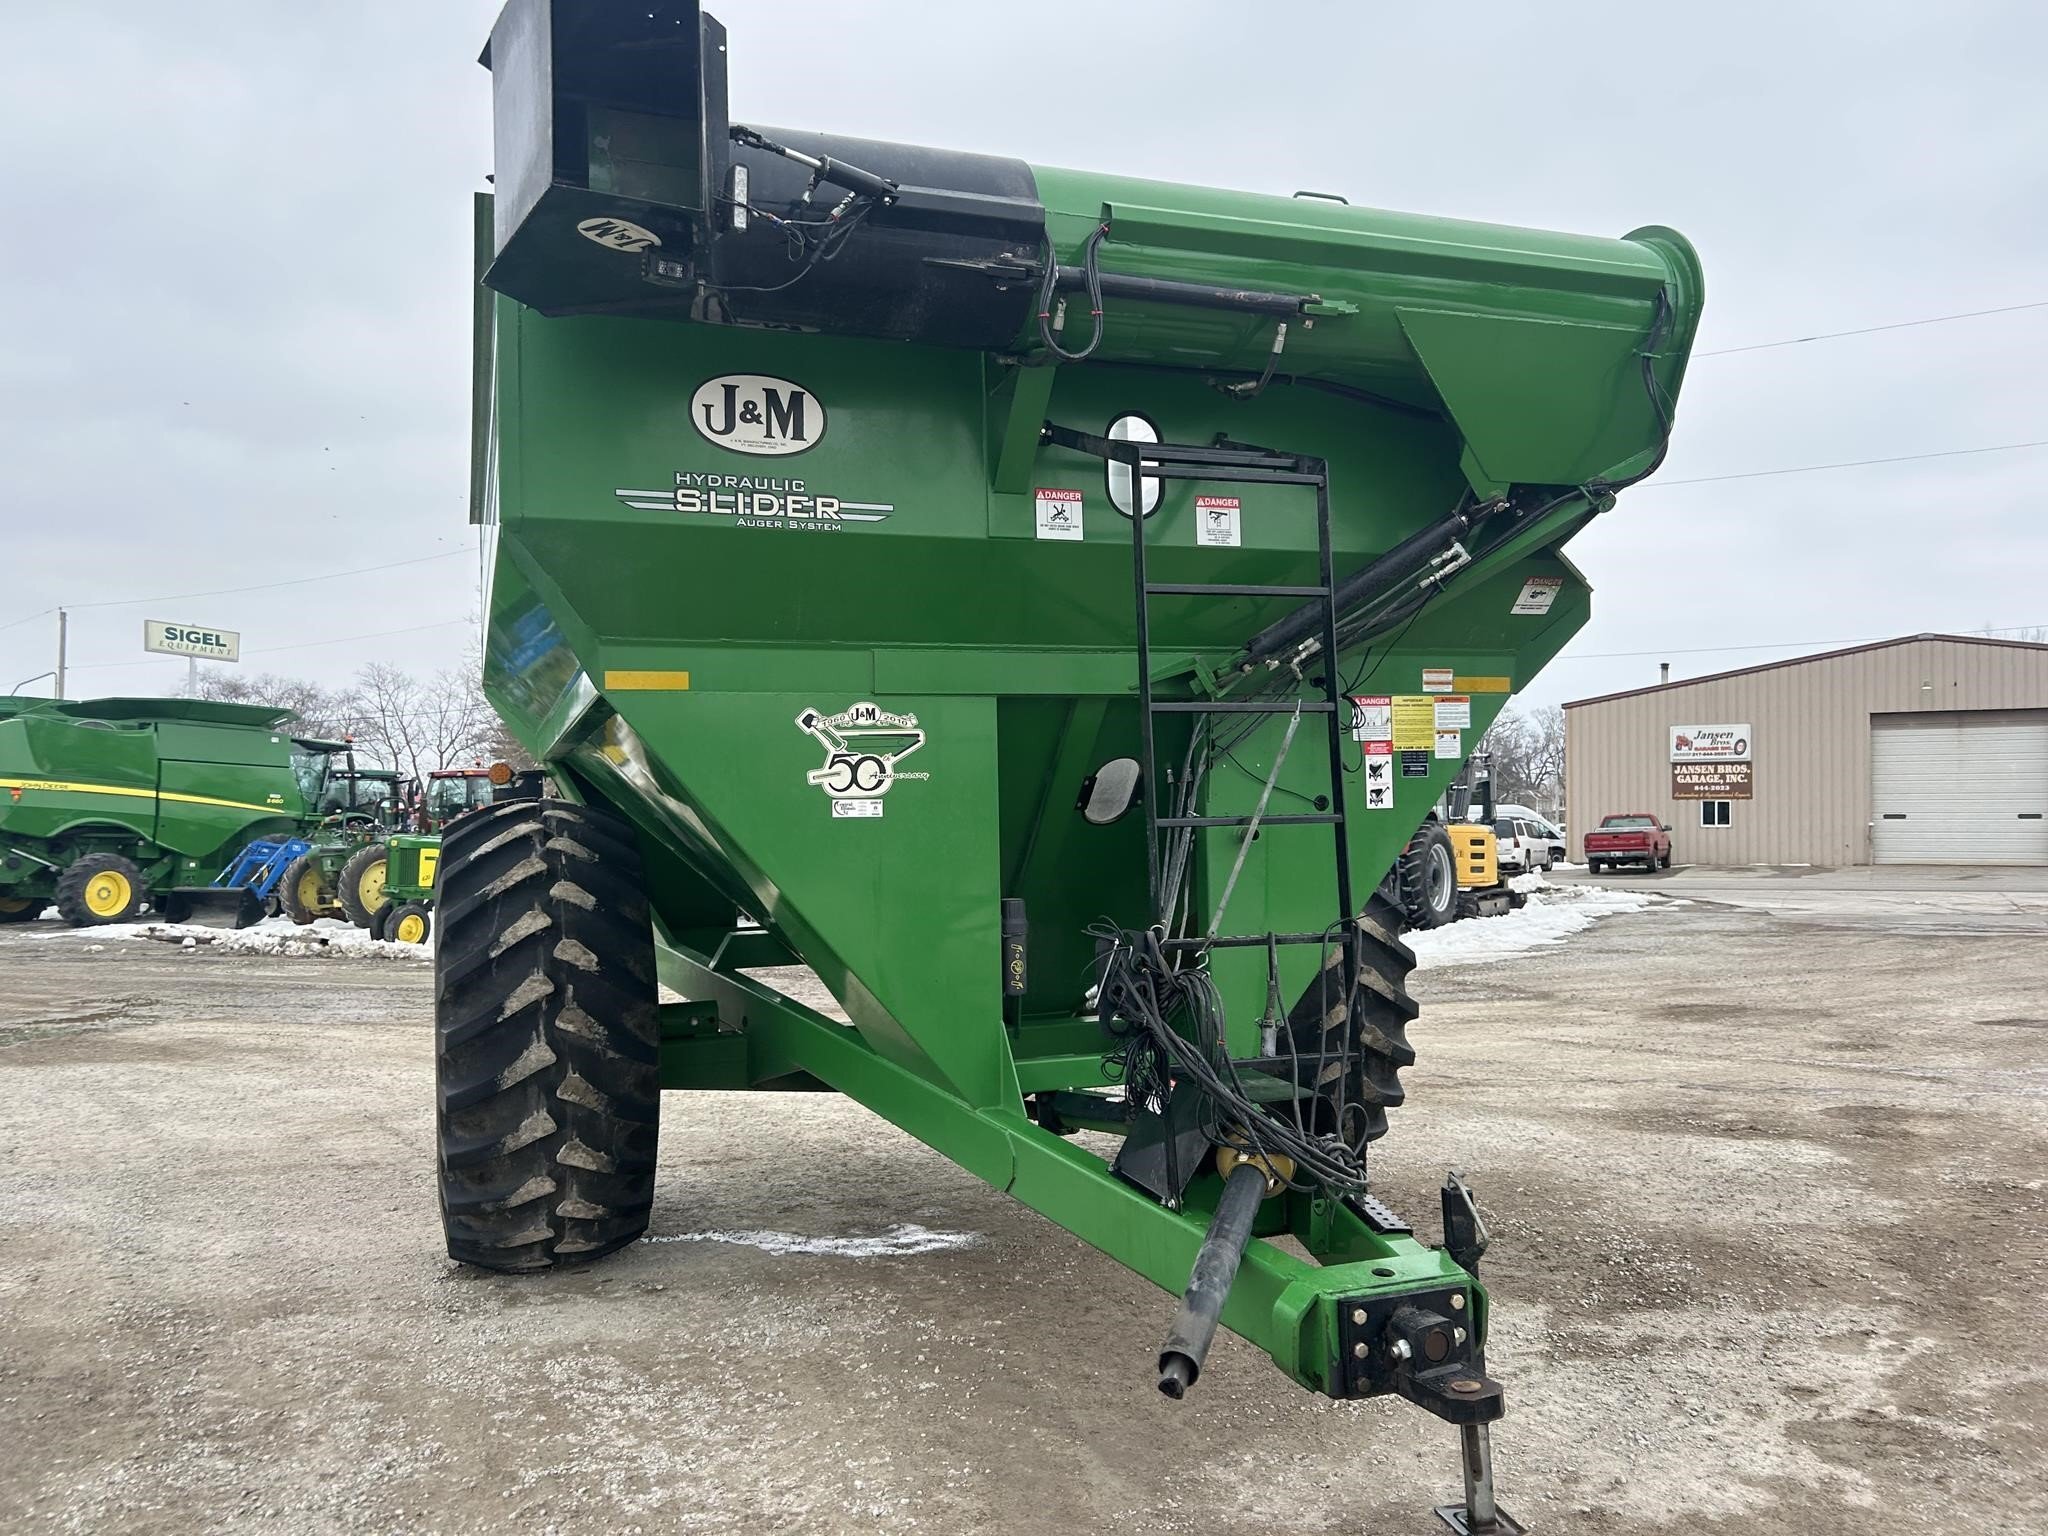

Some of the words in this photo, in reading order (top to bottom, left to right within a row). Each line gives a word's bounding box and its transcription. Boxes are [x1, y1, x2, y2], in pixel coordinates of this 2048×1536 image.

[702, 383, 807, 441] J&M
[675, 472, 806, 492] HYDRAULIC
[1045, 491, 1081, 501] DANGER
[675, 489, 842, 520] SLIDER
[1204, 498, 1239, 507] DANGER
[736, 517, 783, 529] AUGER
[788, 519, 842, 531] SYSTEM
[164, 627, 227, 648] SIGEL
[159, 640, 233, 655] EQUIPMENT
[851, 708, 876, 721] J&M
[884, 715, 908, 726] 2010
[1693, 730, 1734, 740] Jansen
[1710, 738, 1732, 746] Bros.
[1674, 764, 1715, 774] JANSEN
[1717, 764, 1751, 774] BROS.
[868, 770, 930, 781] Anniversary
[1677, 775, 1724, 784] GARAGE,
[1726, 774, 1748, 783] INC.
